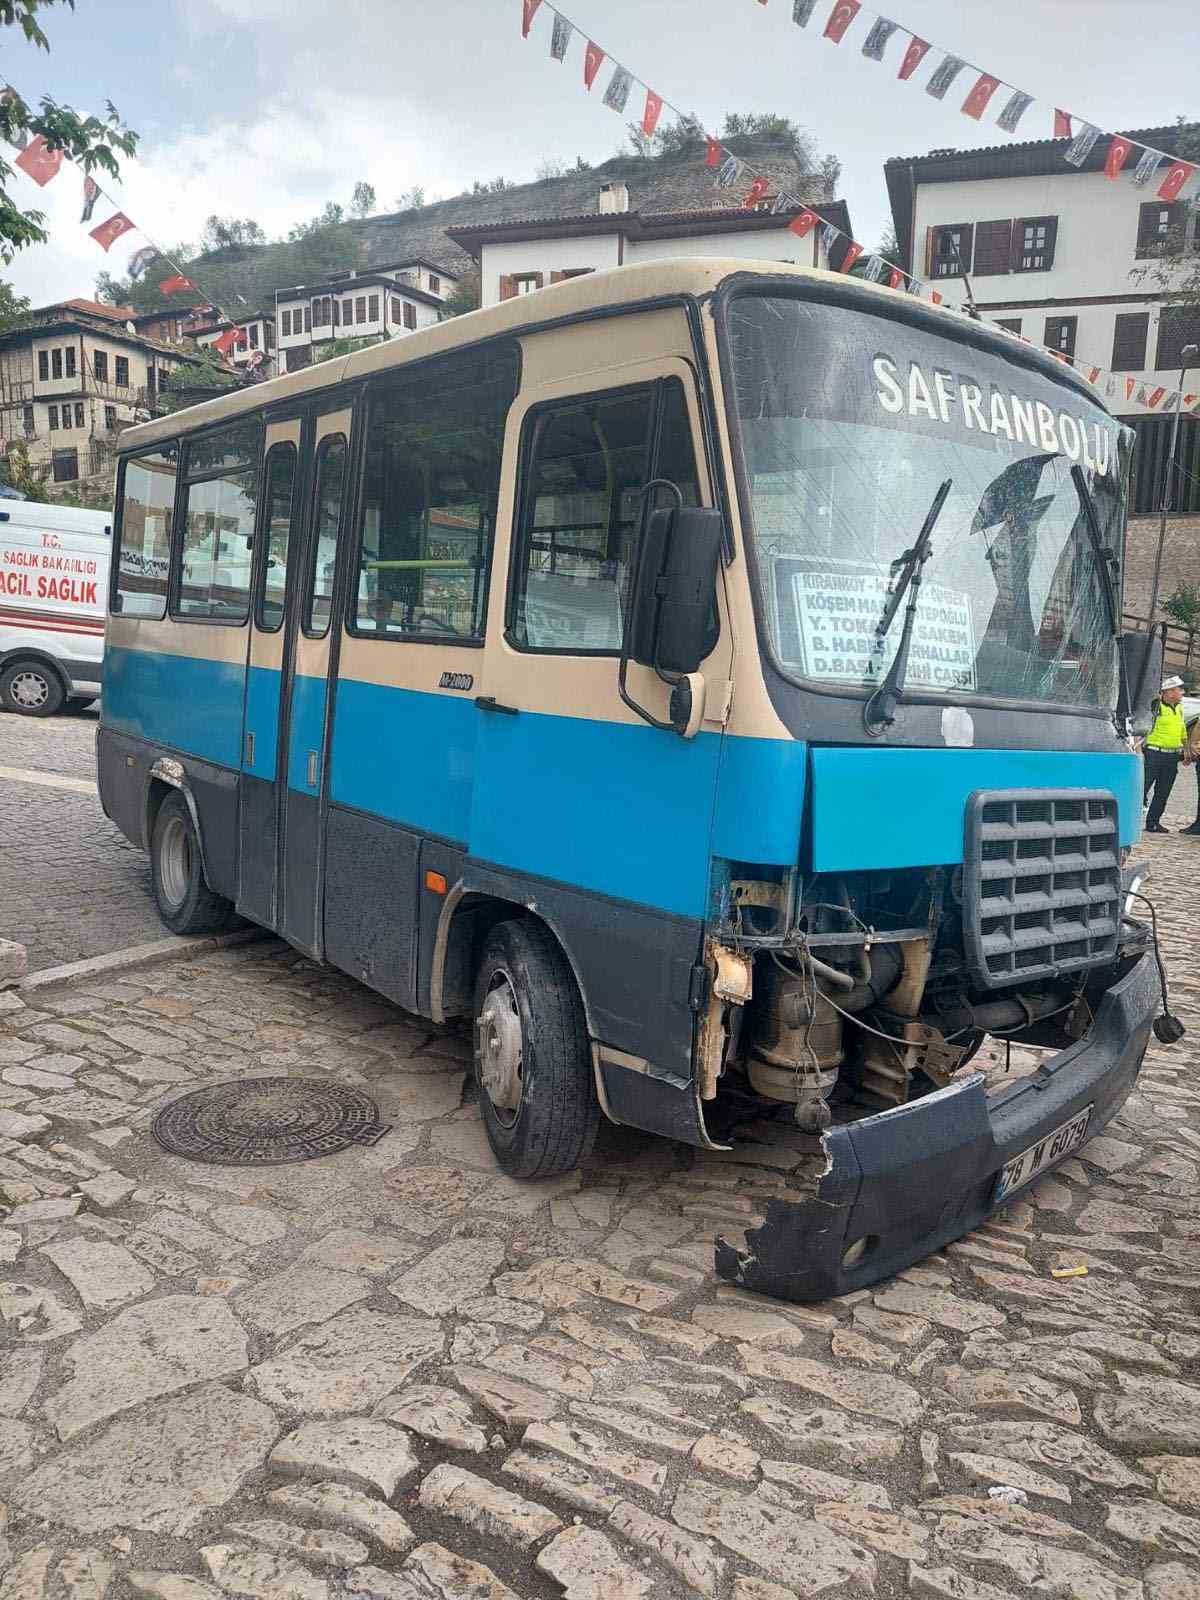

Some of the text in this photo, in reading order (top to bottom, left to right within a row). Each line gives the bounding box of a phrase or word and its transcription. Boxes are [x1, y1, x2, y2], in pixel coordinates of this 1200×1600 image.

[872, 352, 1110, 477] SAFRANBOLU
[38, 575, 97, 605] SAĞLIK
[1005, 1118, 1086, 1188] 78 M 6079
